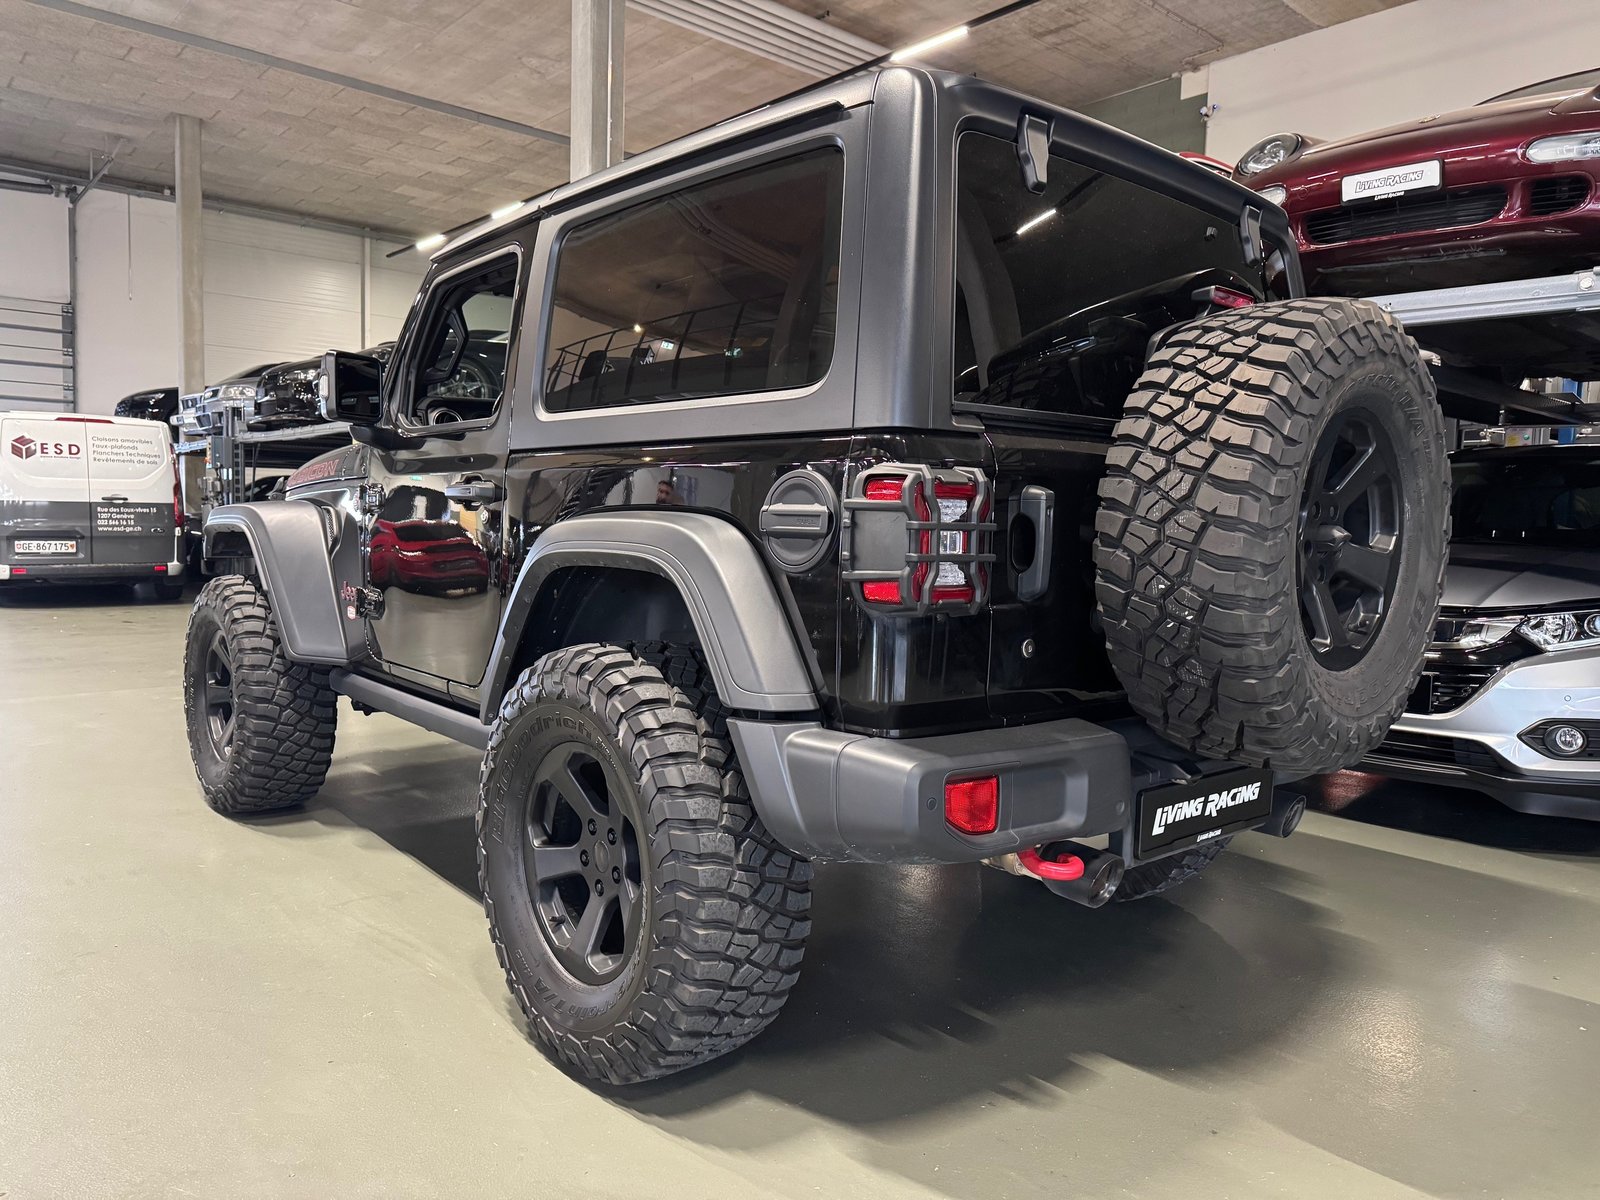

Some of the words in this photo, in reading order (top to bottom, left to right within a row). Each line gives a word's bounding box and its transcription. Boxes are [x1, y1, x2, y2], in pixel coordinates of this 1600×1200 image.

[40, 443, 81, 455] ESD
[125, 451, 161, 459] Techniques
[341, 580, 358, 601] Jee
